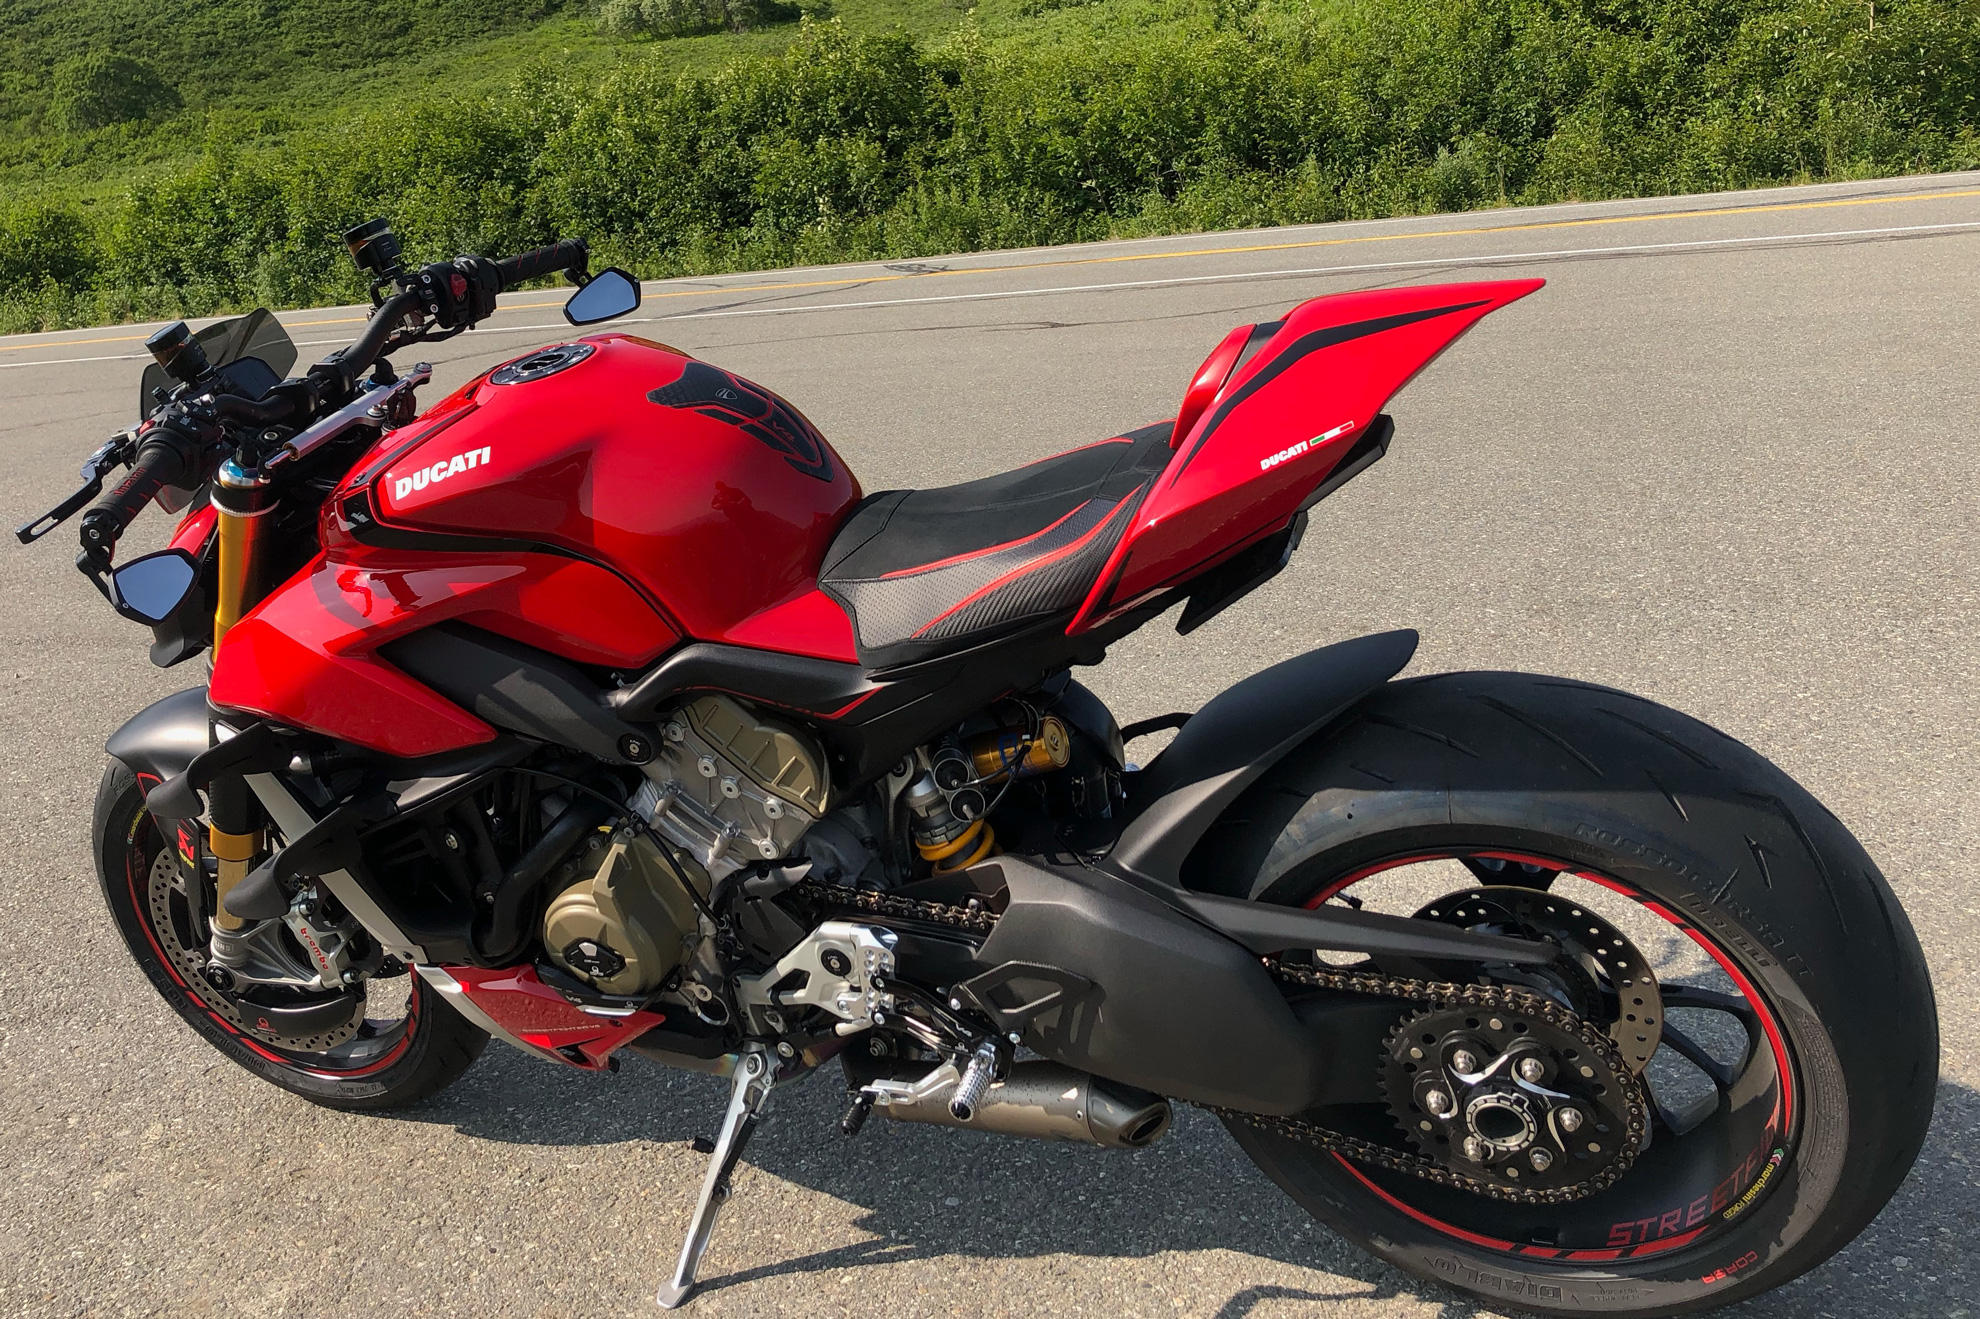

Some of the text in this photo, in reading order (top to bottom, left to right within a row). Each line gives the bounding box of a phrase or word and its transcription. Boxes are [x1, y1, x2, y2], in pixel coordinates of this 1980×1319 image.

[395, 446, 491, 501] DUCATI
[1260, 440, 1309, 471] DUCATI
[300, 927, 329, 971] brembo
[1742, 1161, 1774, 1204] marchesini
[1701, 1250, 1758, 1284] CORSA
